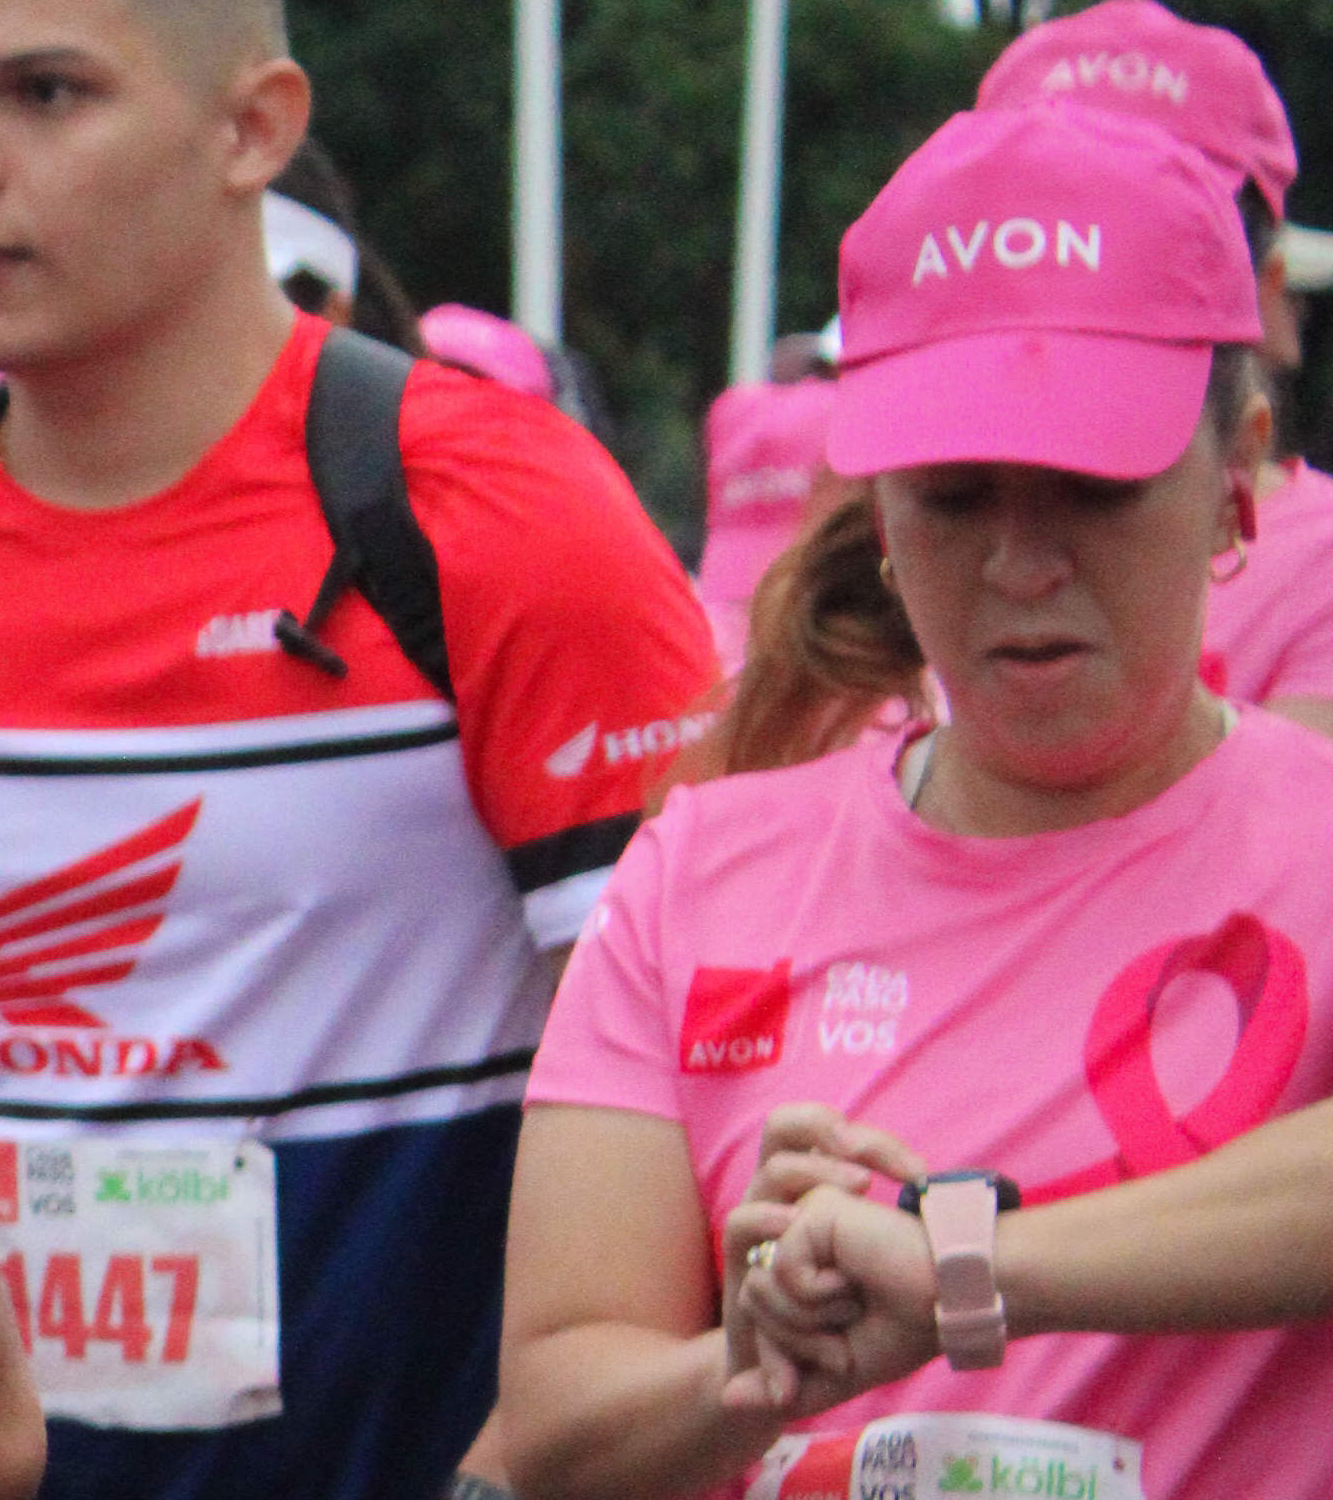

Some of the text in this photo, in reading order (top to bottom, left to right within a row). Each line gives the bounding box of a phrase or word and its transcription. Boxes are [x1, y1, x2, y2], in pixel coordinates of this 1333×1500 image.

[1039, 50, 1189, 106] AVON
[911, 216, 1102, 289] AVON
[604, 712, 717, 765] HON
[688, 1034, 775, 1069] AVON
[818, 1018, 899, 1055] VOS
